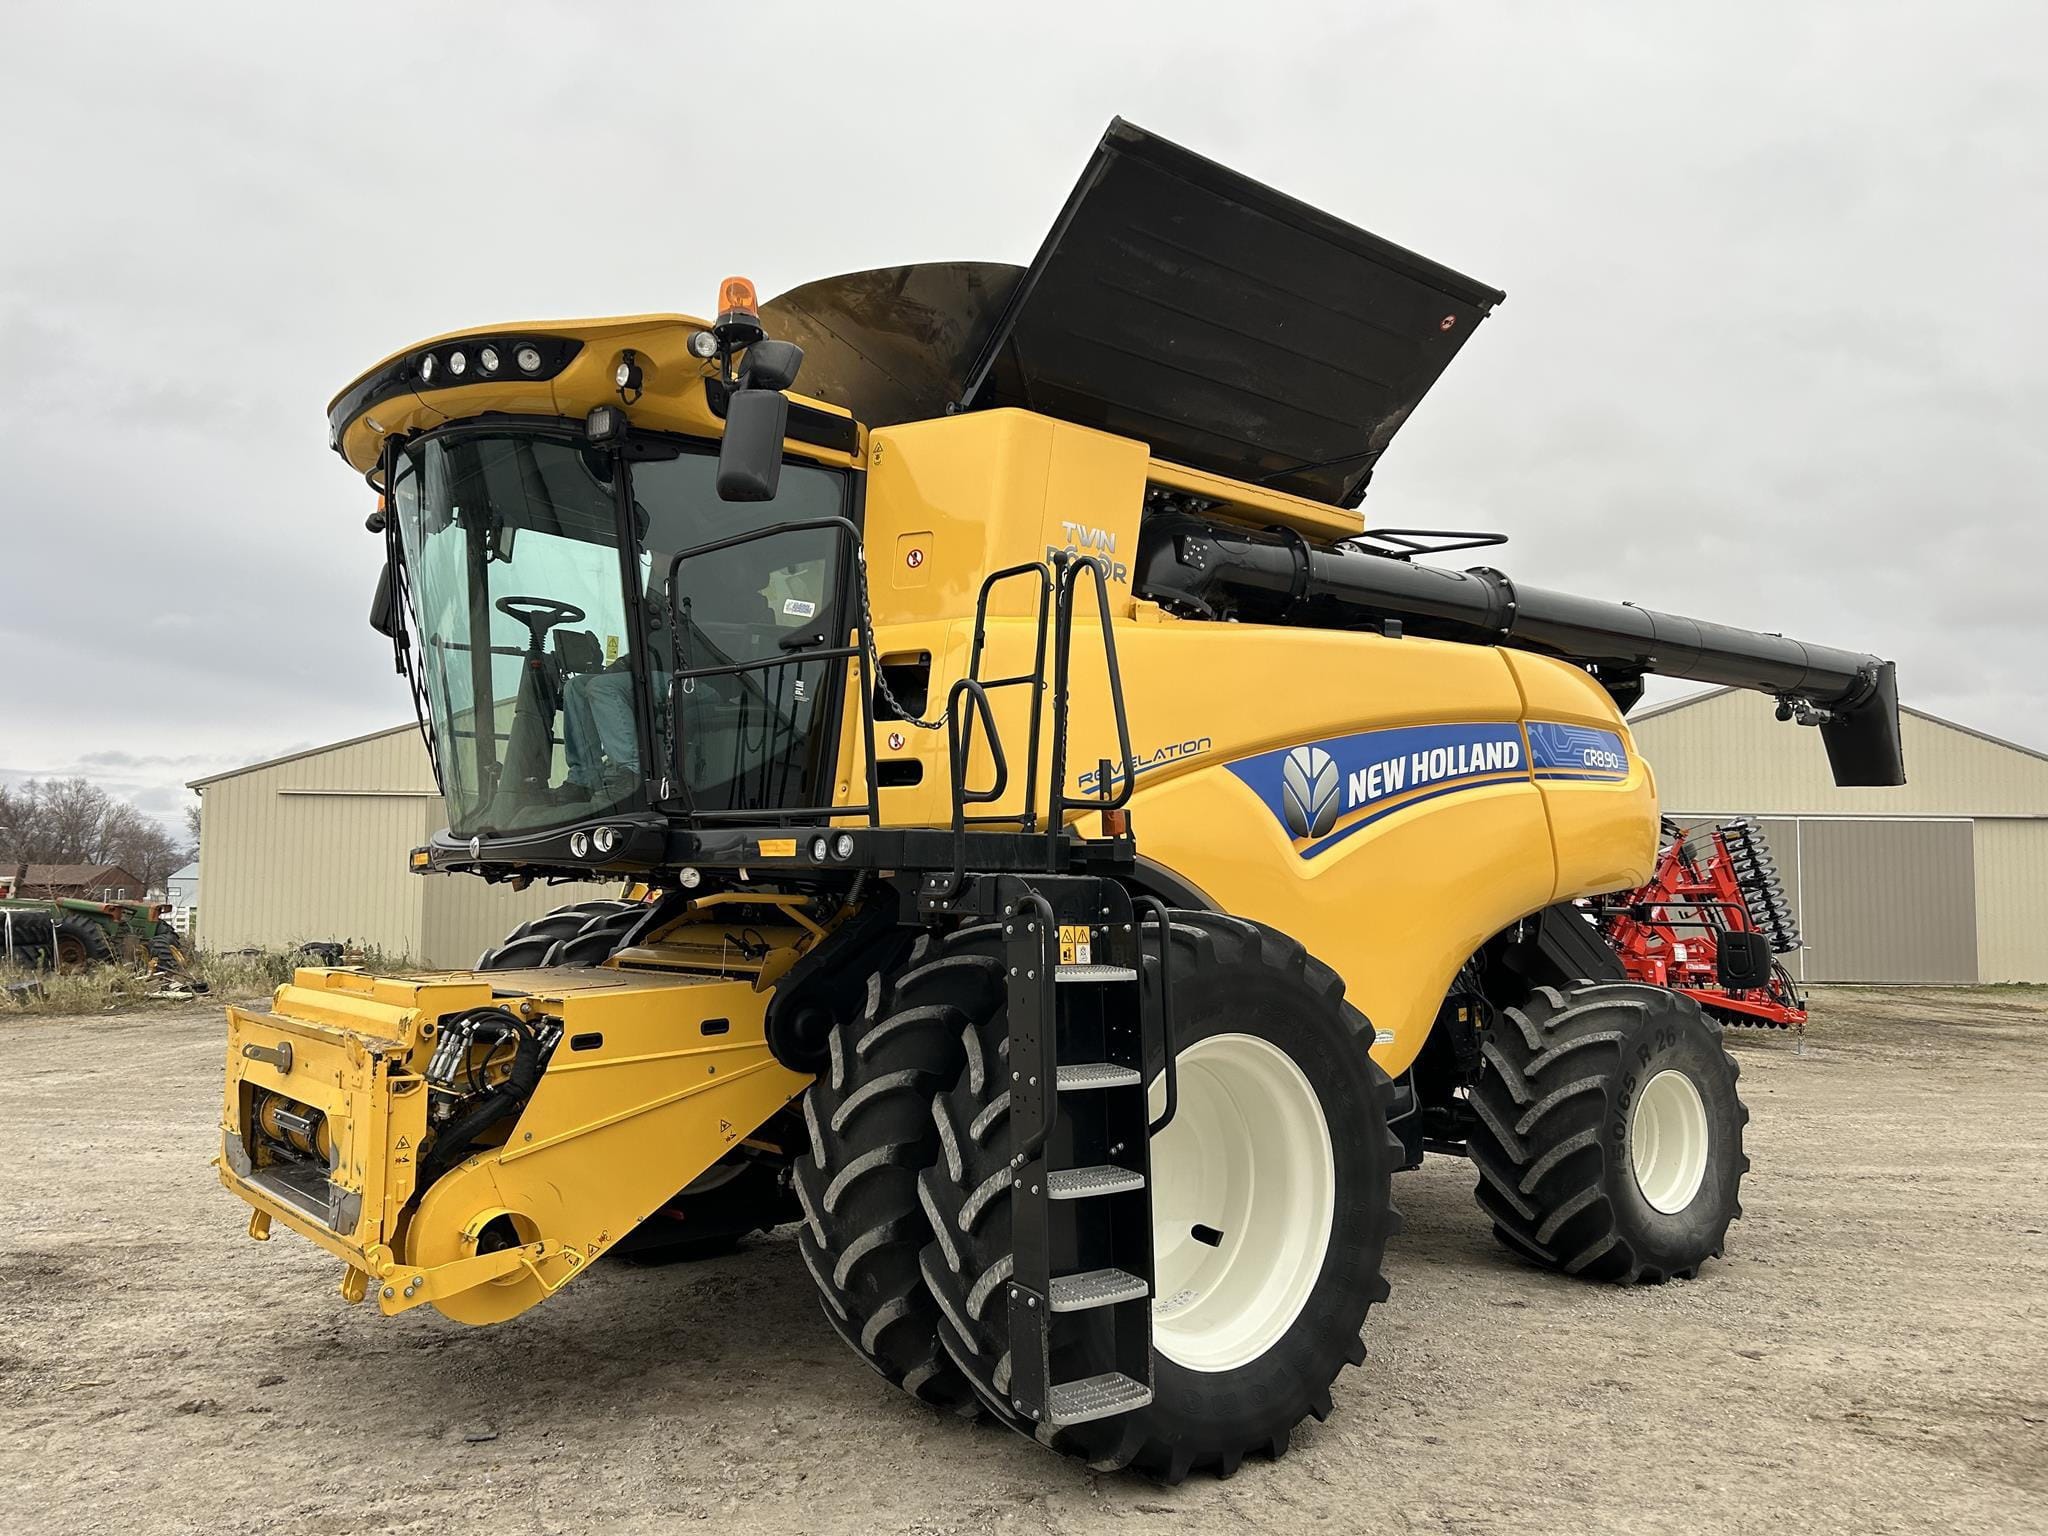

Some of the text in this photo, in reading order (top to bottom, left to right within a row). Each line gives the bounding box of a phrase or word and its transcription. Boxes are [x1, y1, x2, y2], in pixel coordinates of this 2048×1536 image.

[1061, 520, 1116, 554] TWIN
[1046, 544, 1128, 585] ROOR
[1348, 740, 1520, 809] NEW HOLLAND
[1583, 748, 1619, 769] CR8.90
[1636, 1042, 1652, 1069] R
[1655, 1023, 1677, 1054] 26
